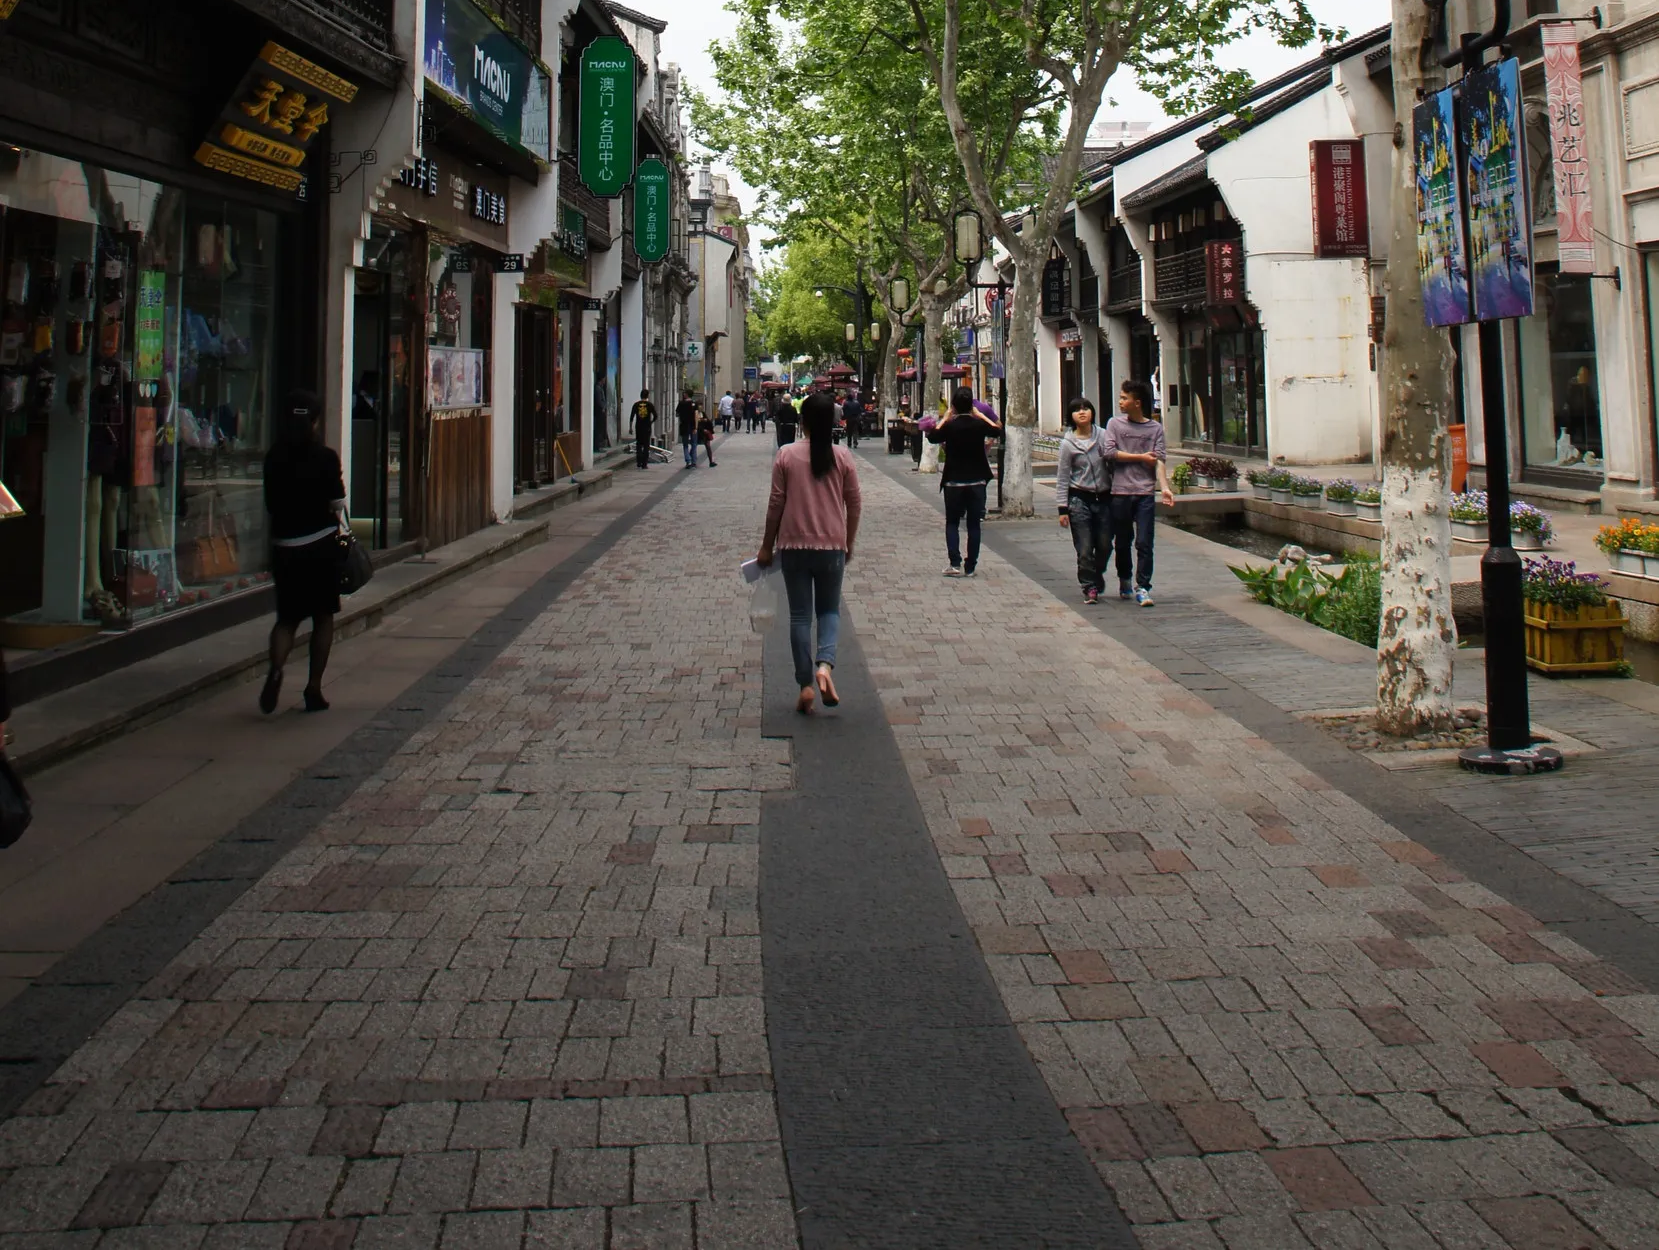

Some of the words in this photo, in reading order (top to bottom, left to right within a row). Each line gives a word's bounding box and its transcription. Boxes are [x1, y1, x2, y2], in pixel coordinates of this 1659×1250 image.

[474, 44, 511, 104] MACAU
[240, 78, 329, 142] 天堂伞
[598, 77, 614, 181] 澳门·名品中心
[1556, 103, 1587, 197] 兆艺汇
[474, 185, 506, 225] 澳门美食
[503, 261, 516, 270] 29
